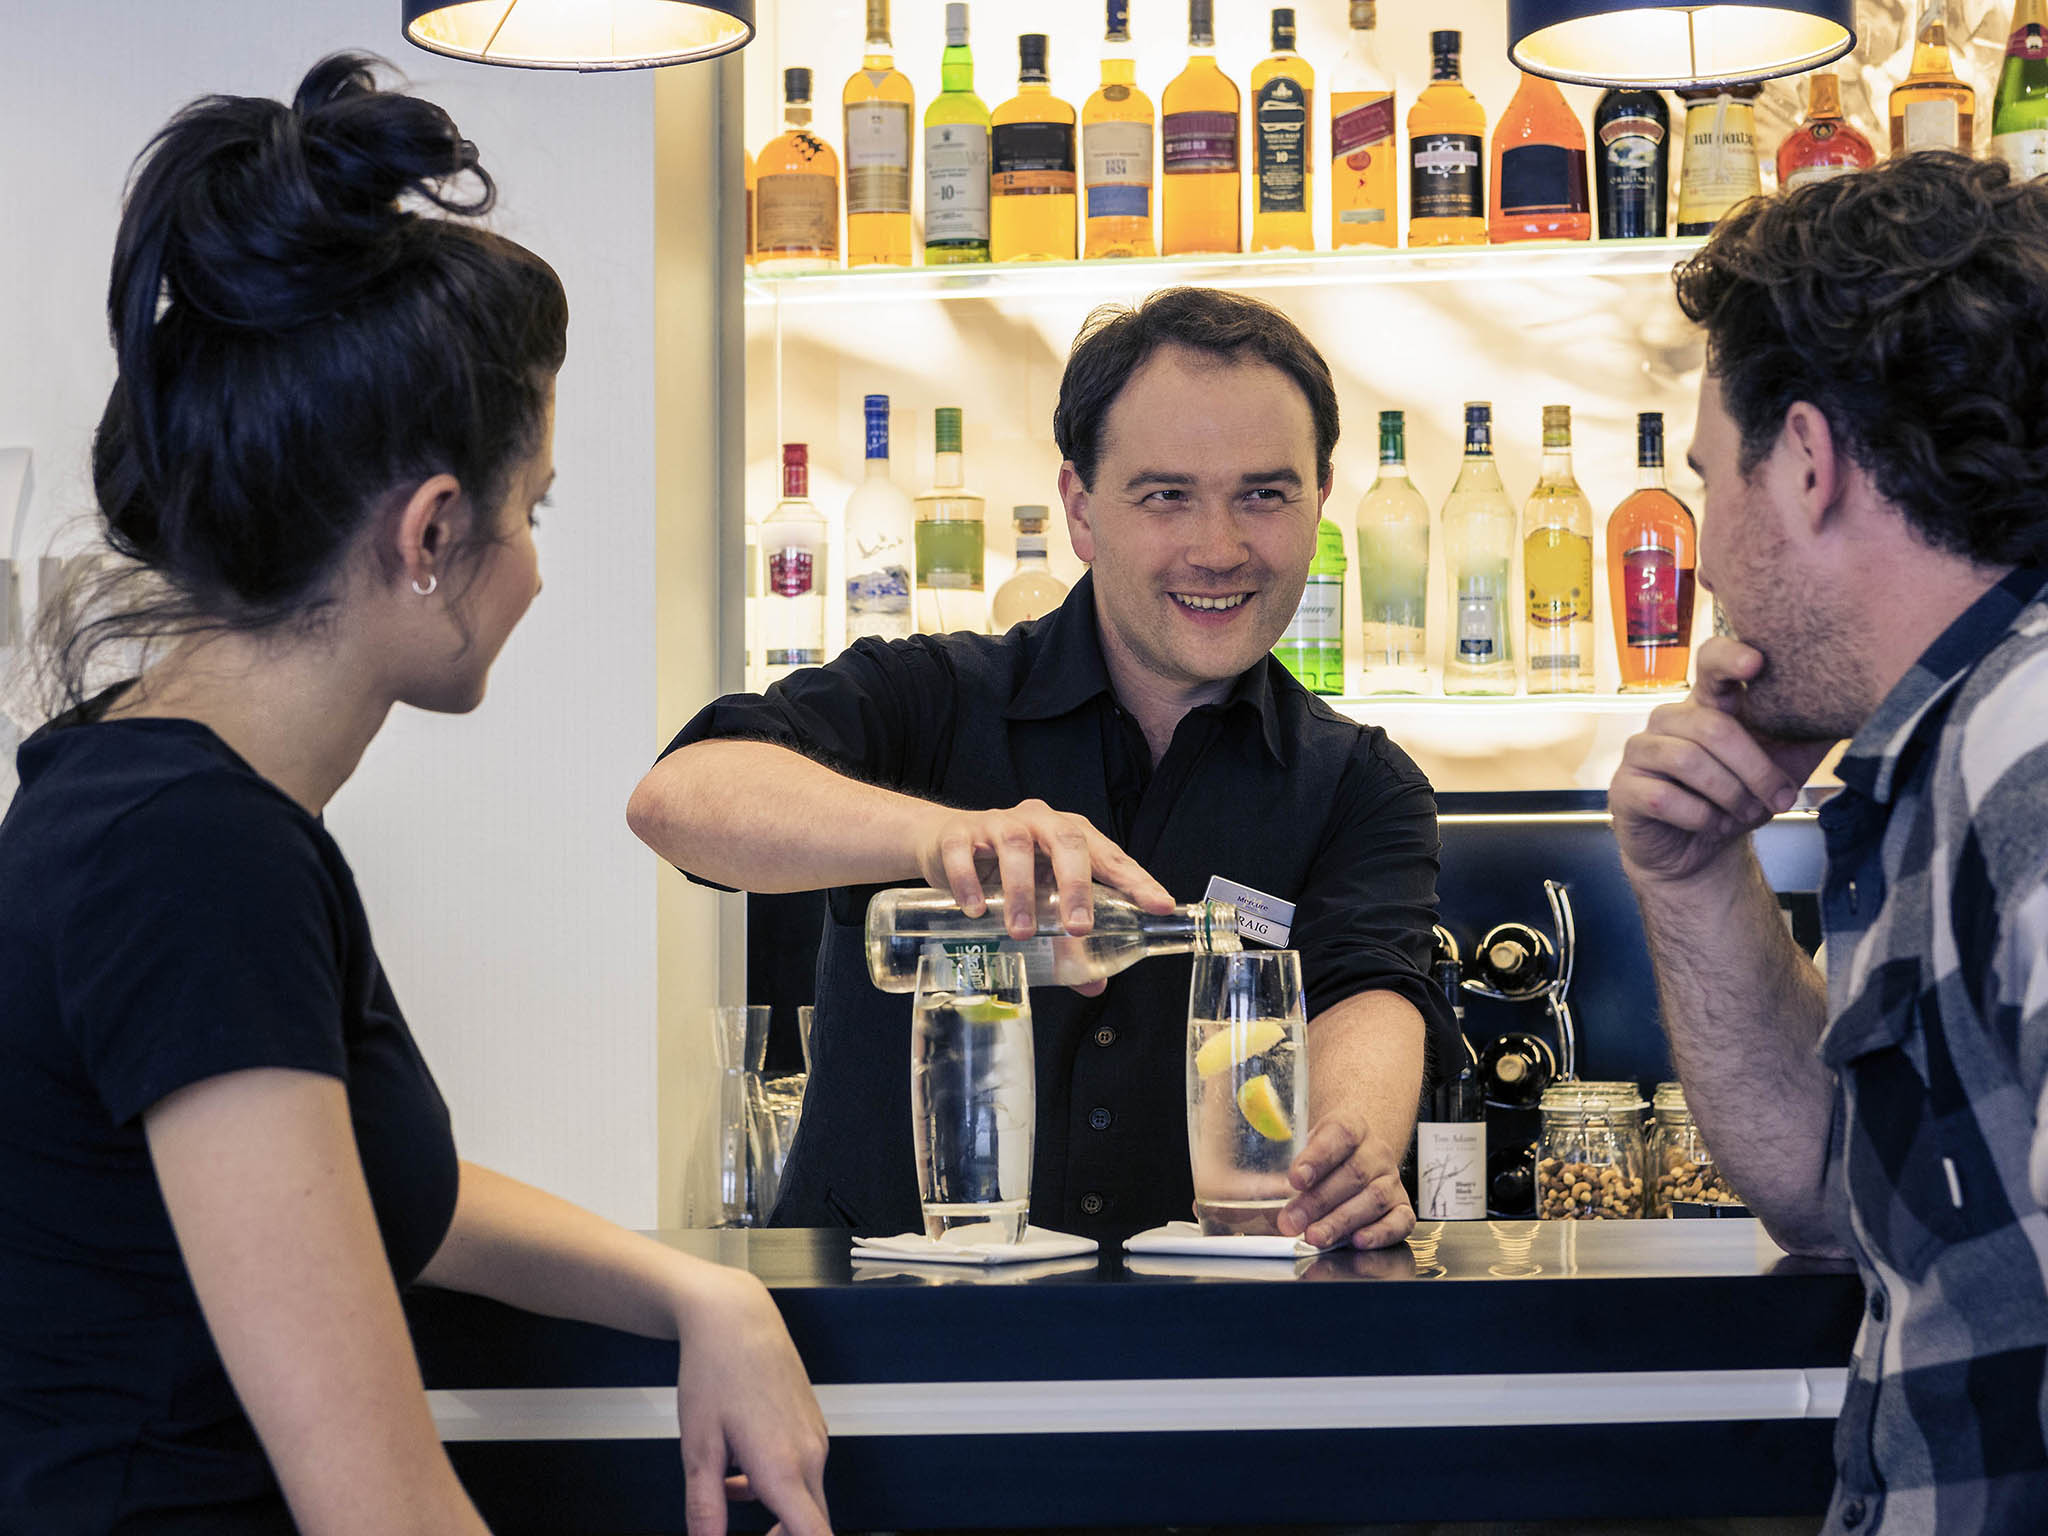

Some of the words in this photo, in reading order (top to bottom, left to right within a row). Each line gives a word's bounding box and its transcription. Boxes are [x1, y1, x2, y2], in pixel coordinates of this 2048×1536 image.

[1276, 151, 1289, 163] 10
[1002, 174, 1015, 186] 12
[940, 184, 955, 201] 10
[1640, 566, 1657, 590] 5
[1236, 895, 1269, 912] Mercure
